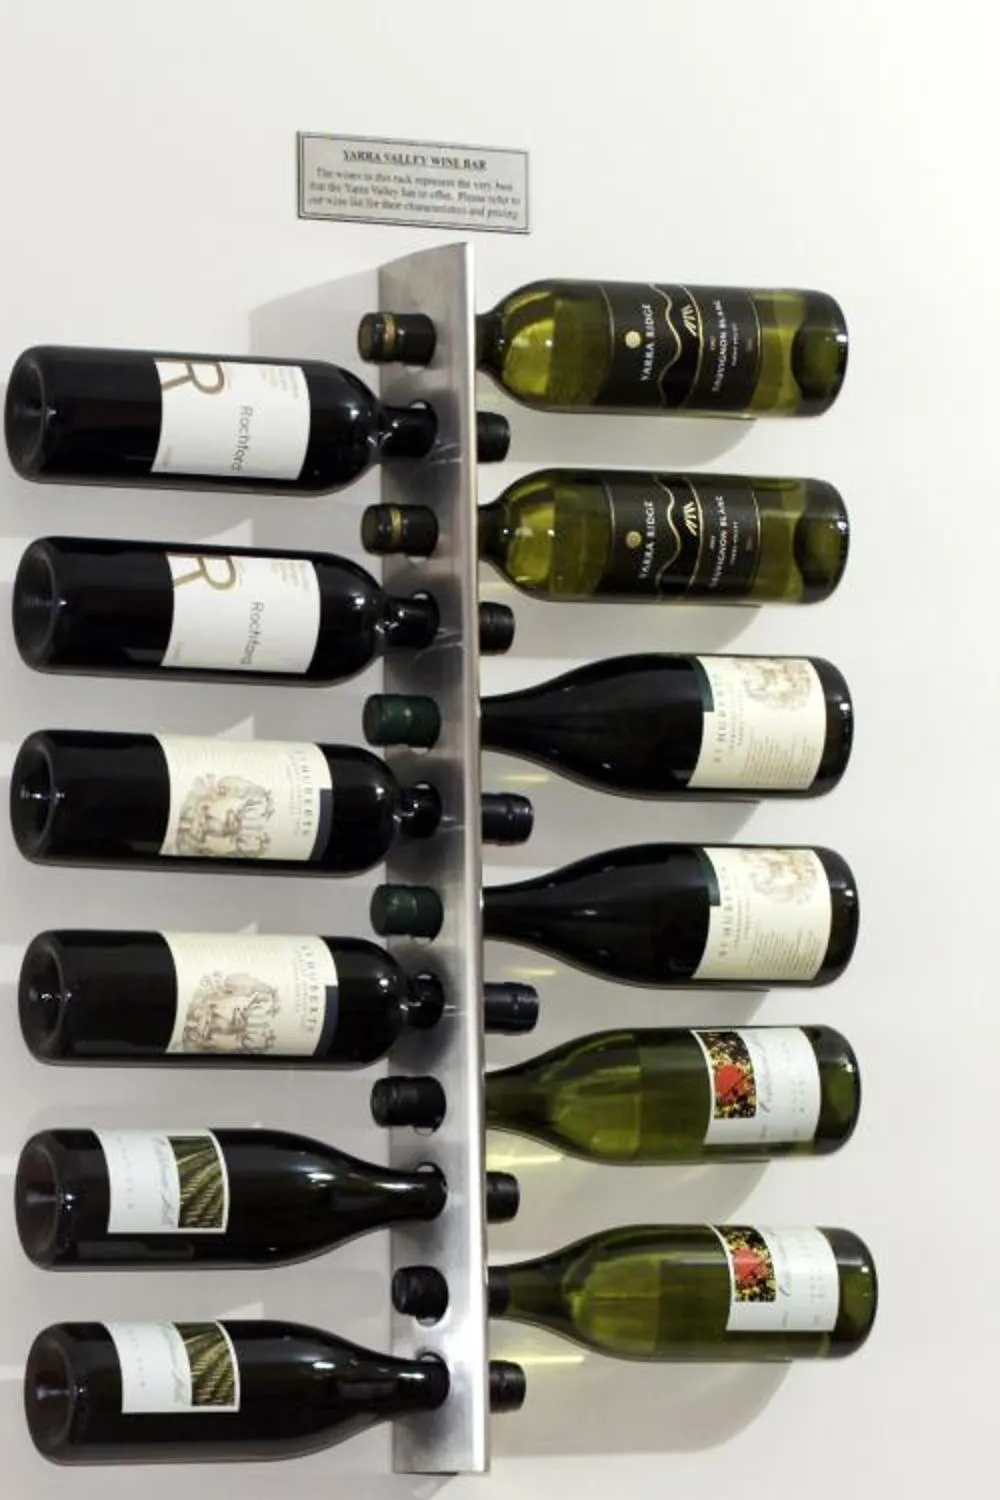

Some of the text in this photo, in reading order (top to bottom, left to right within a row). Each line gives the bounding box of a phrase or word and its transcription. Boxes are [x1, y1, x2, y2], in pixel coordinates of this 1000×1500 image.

[343, 150, 487, 171] YARRA VALLEY WINE BAR
[639, 303, 656, 382] YARRA RIDGE
[161, 361, 226, 395] R
[230, 404, 254, 472] Rochford
[638, 499, 656, 579] YARRA RIDGE
